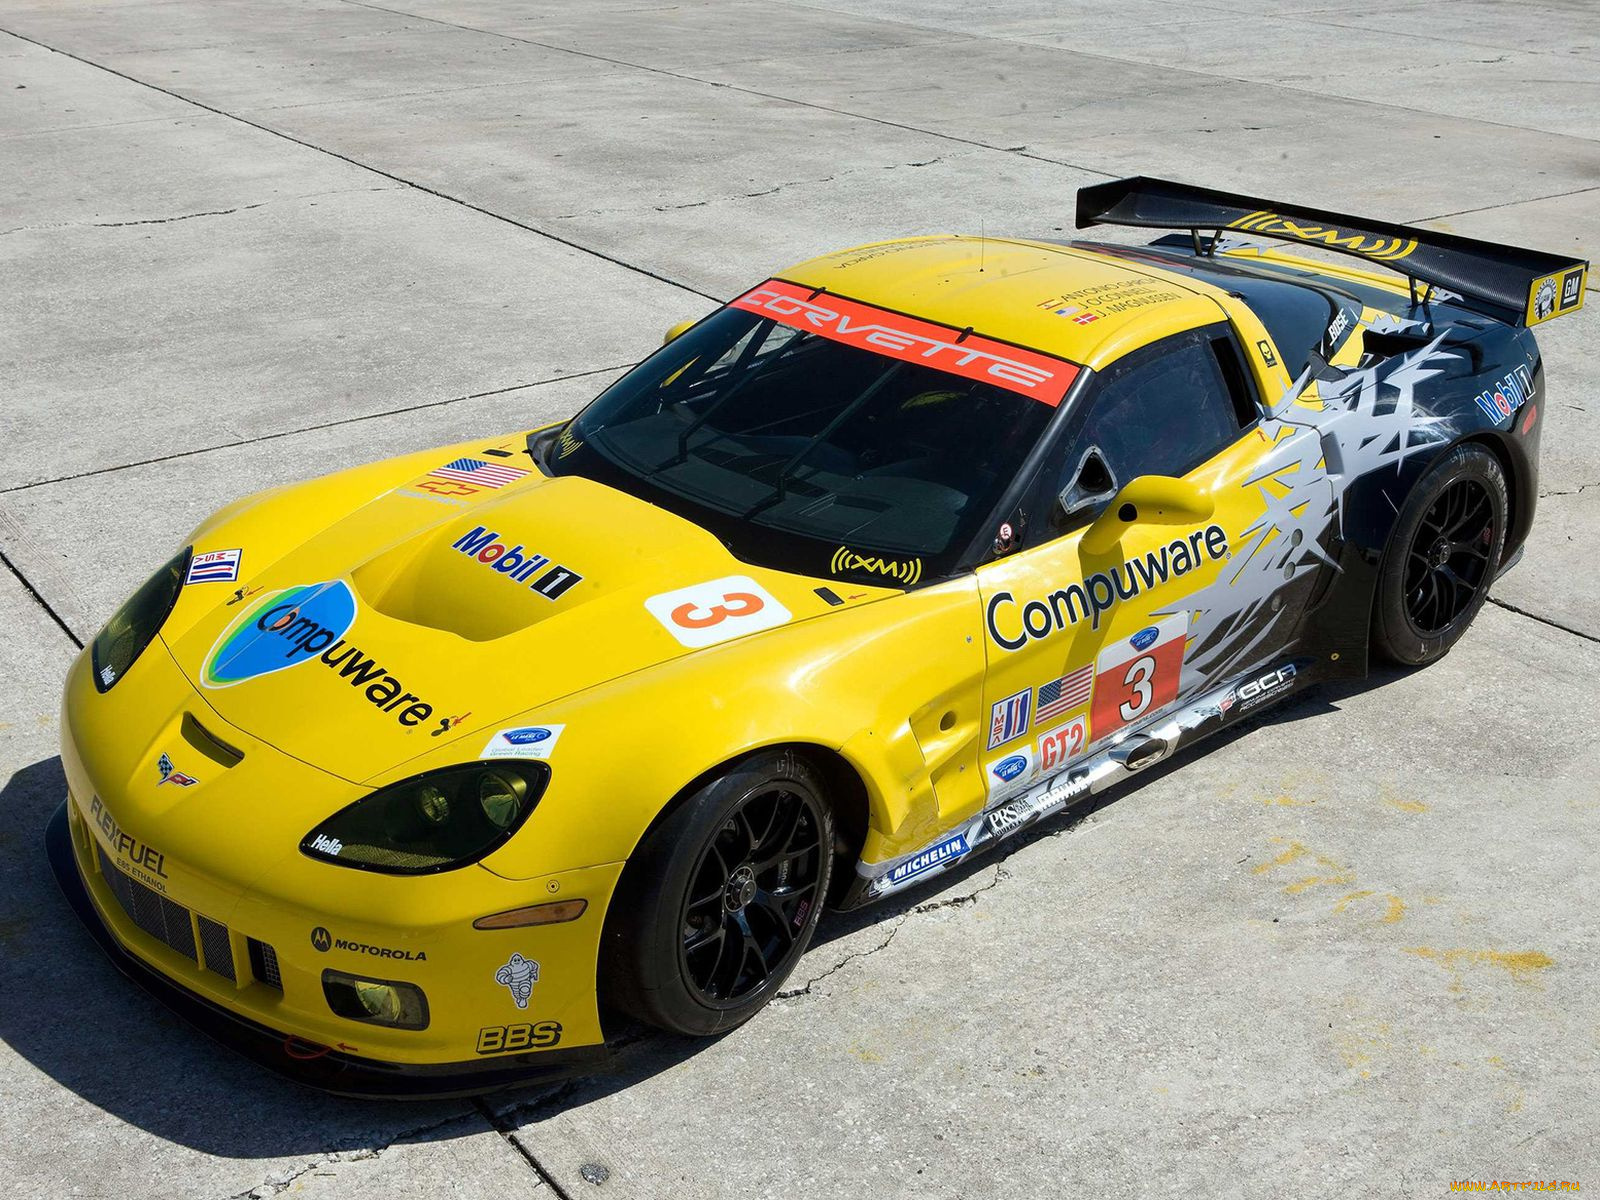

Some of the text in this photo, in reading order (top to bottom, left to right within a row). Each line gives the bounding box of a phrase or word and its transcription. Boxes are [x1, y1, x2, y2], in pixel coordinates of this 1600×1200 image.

[1564, 275, 1580, 298] GM
[741, 288, 1055, 388] CORVETTE
[1327, 307, 1350, 347] BOSE
[1474, 372, 1526, 427] Mobil
[451, 525, 552, 583] Mobil
[986, 524, 1229, 651] Compuware
[670, 591, 765, 629] 3
[256, 603, 434, 727] Compuware
[1239, 663, 1297, 700] GCA
[1119, 654, 1157, 722] 3
[991, 704, 1005, 746] IMSA
[1042, 722, 1084, 771] GT2
[988, 804, 1018, 830] PRS
[310, 833, 343, 856] Hella
[894, 839, 962, 880] MICHELIN
[131, 866, 168, 894] ETHANOL
[335, 938, 428, 961] MOTOROLA
[475, 1020, 563, 1056] BBS
